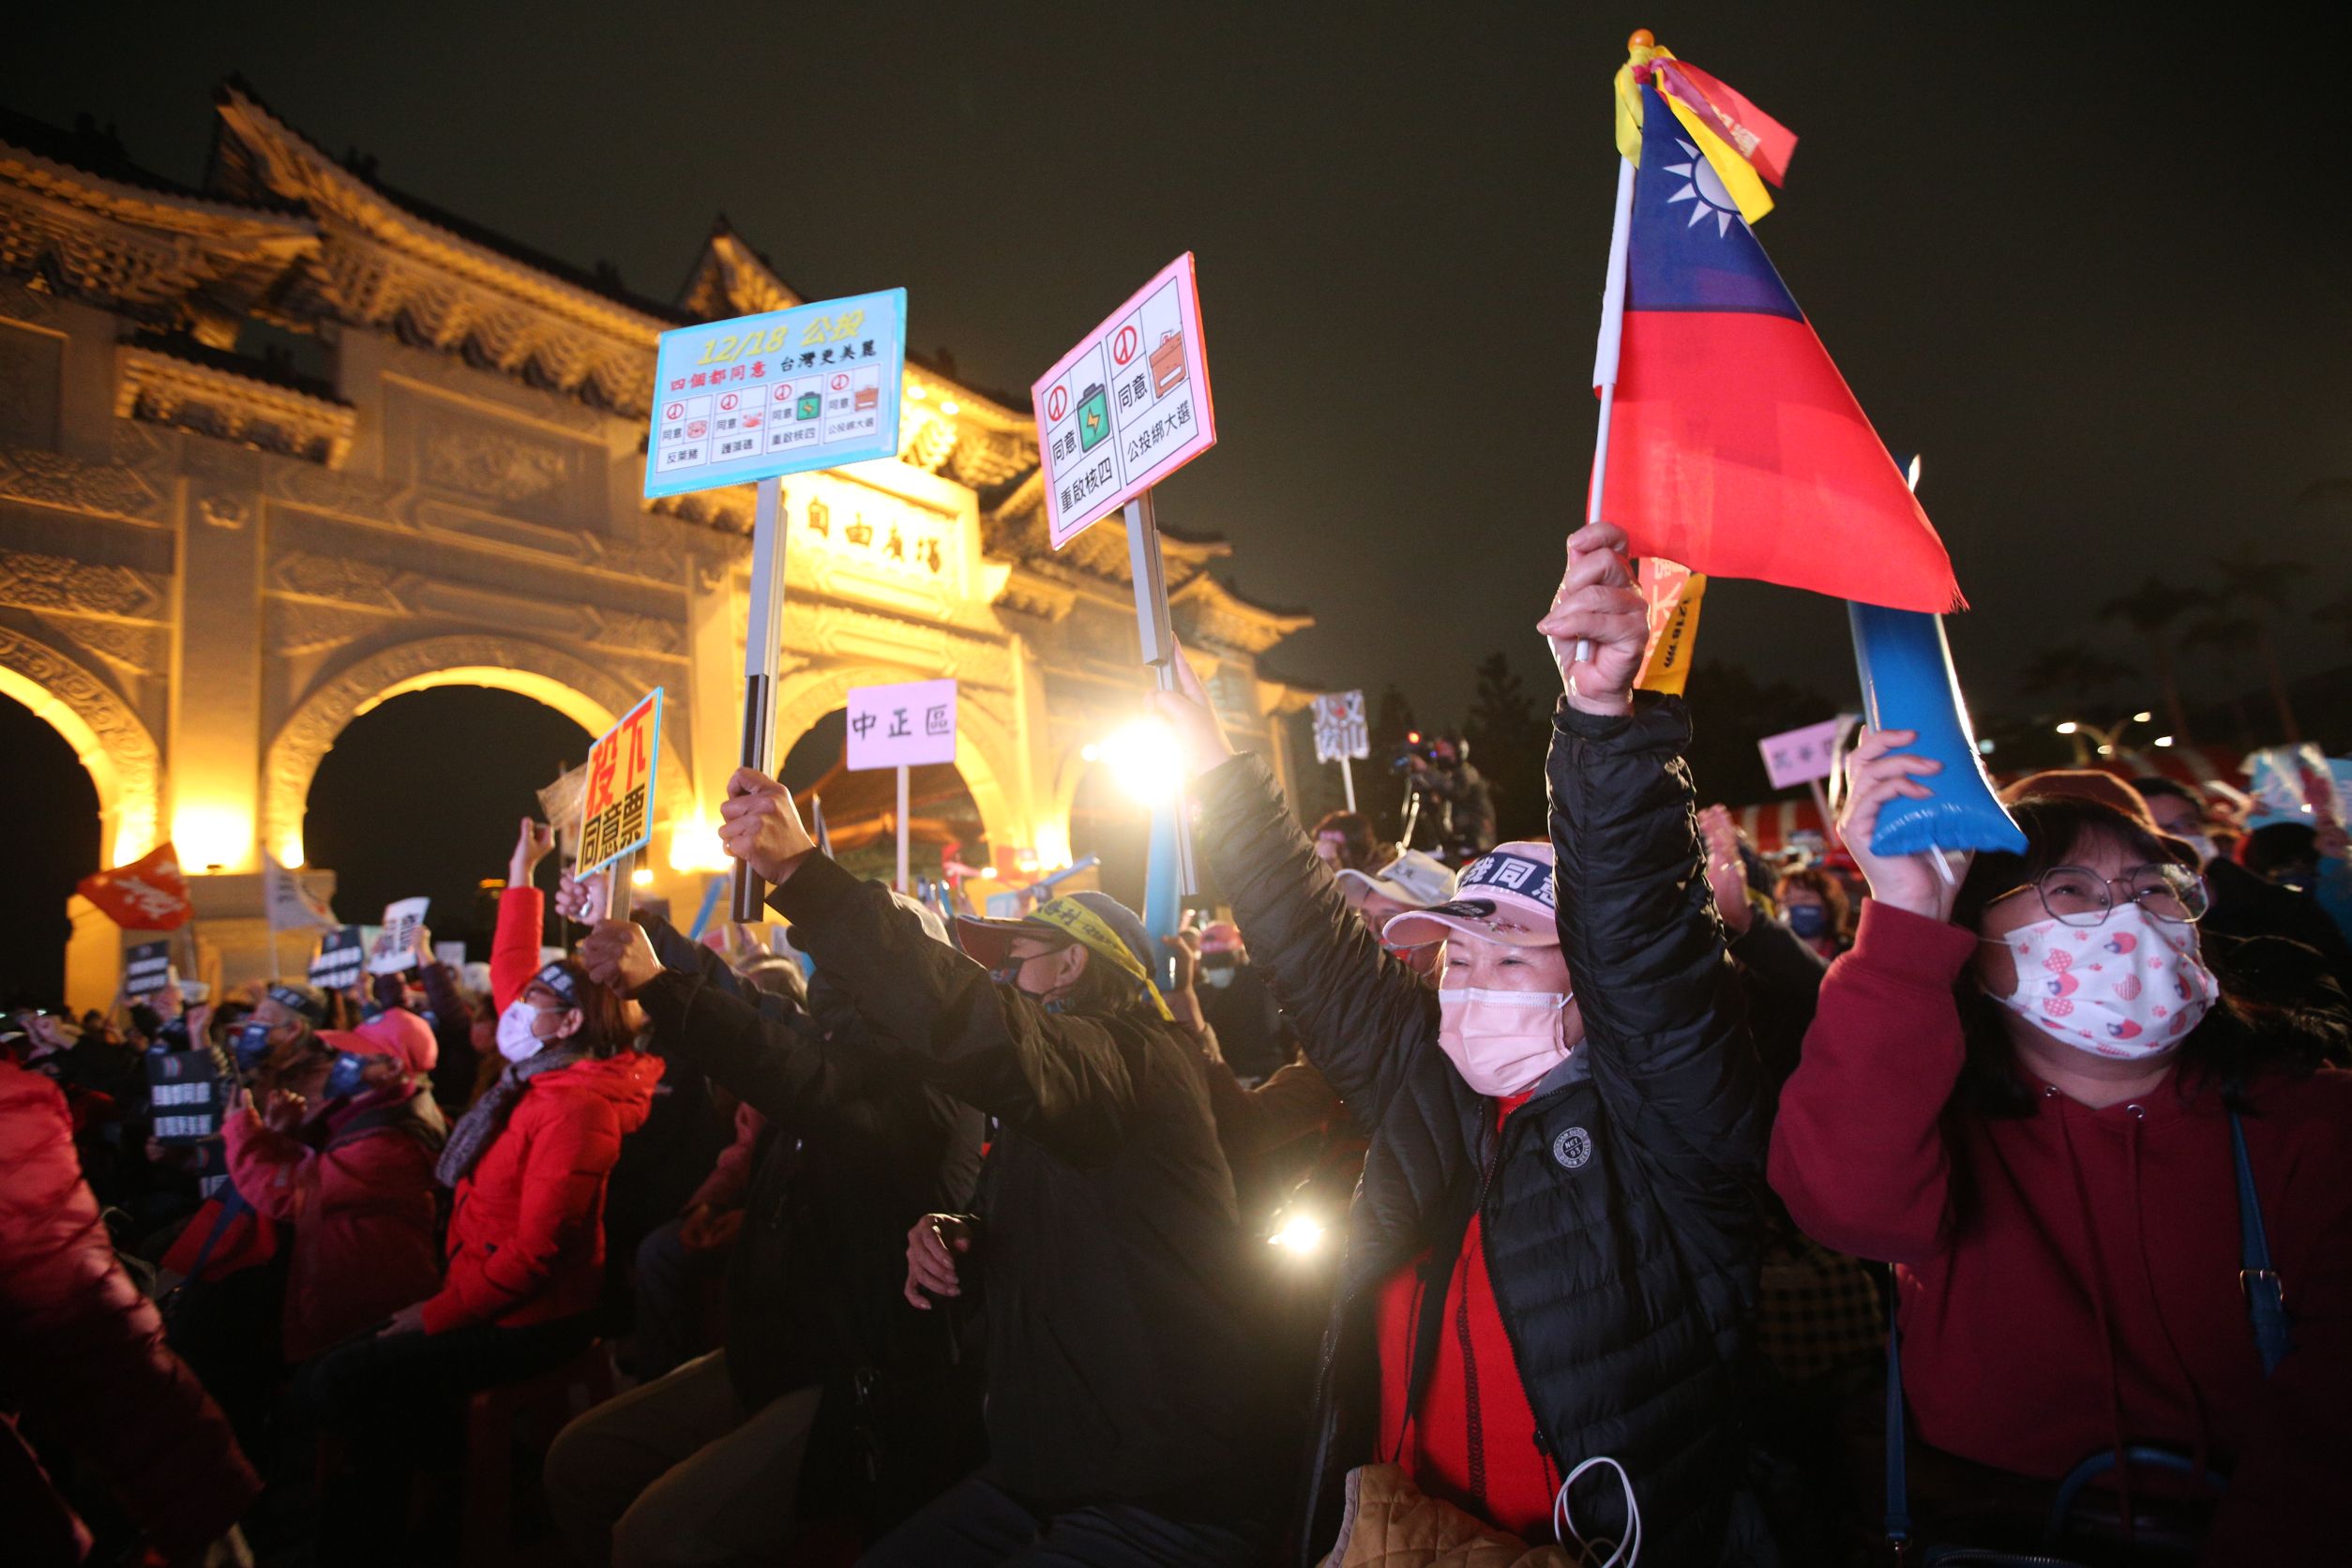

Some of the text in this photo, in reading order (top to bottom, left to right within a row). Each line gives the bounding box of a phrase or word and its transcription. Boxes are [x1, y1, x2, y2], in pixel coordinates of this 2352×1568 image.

[698, 309, 865, 366] 12/18 公投
[670, 339, 878, 392] 四個都同意 台灣更美麗
[772, 407, 793, 420] 同意
[828, 397, 850, 411] 同意
[1118, 372, 1149, 415] 同意
[662, 428, 683, 441] 同意
[716, 417, 738, 430] 同意
[772, 427, 817, 446] 重啟核四
[1126, 400, 1192, 464] 公投綁大選
[1051, 430, 1078, 466] 同意
[1061, 457, 1113, 514] 重啟核四
[852, 704, 950, 741] 中正區
[587, 699, 654, 821] 投下
[580, 782, 646, 874] 同意票
